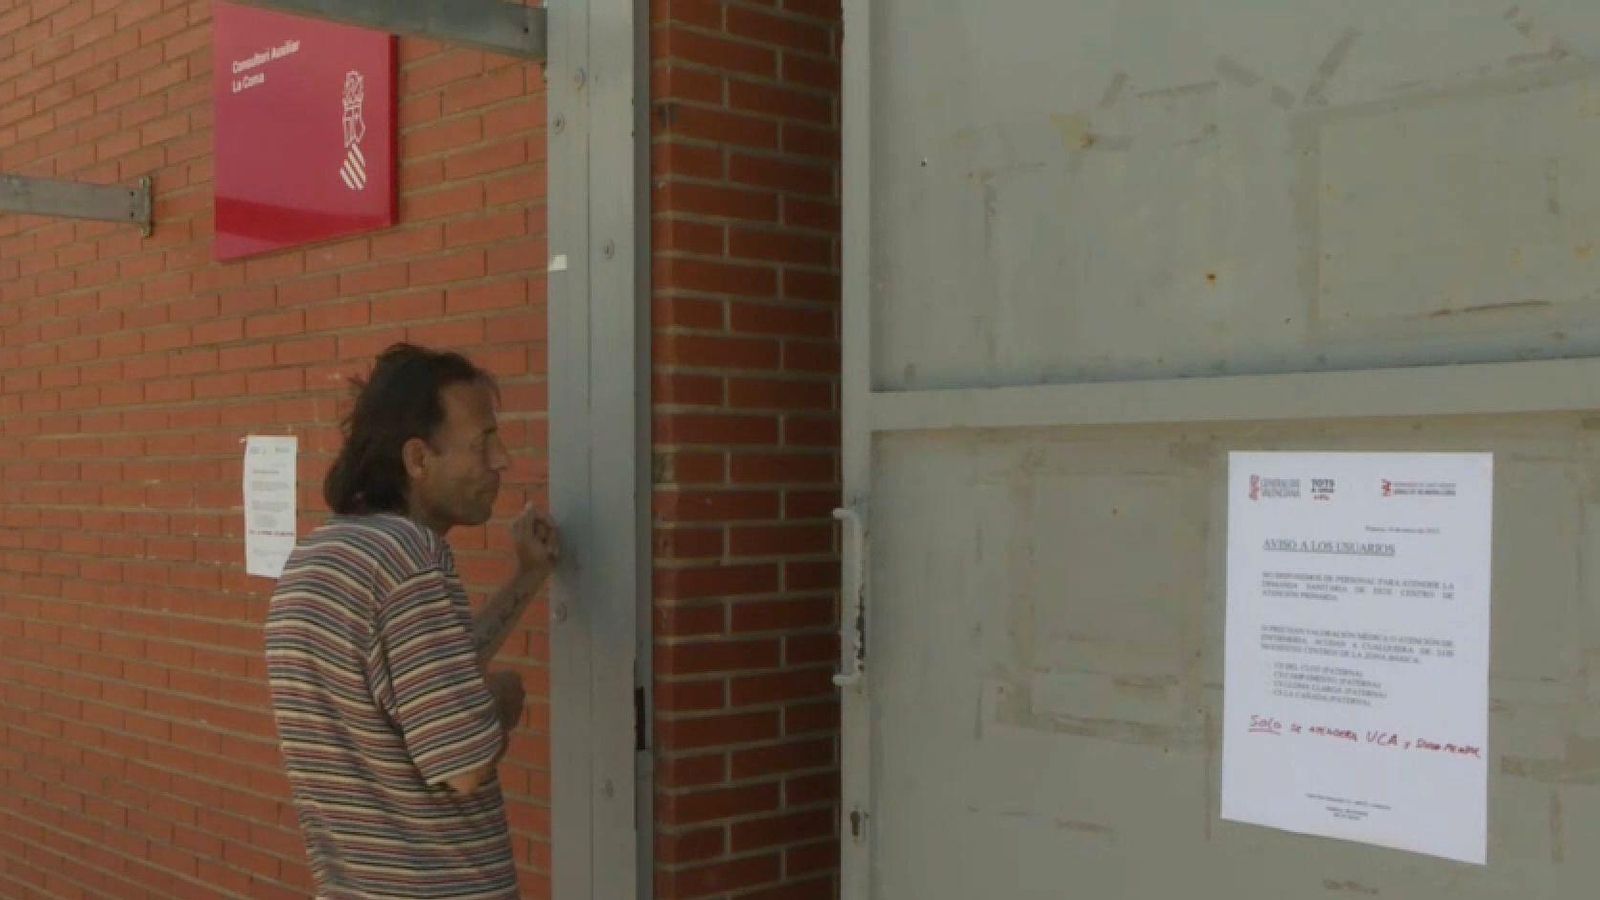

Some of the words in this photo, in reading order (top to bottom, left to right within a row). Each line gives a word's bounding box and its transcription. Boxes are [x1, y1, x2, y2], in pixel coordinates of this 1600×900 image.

[232, 51, 270, 74] Consultori
[271, 39, 300, 60] Auxiliar
[232, 79, 242, 93] La
[243, 72, 265, 89] Coma
[1263, 538, 1297, 552] AVISO
[1299, 540, 1309, 553] A
[1310, 540, 1334, 554] LOS
[1336, 541, 1395, 557] USUARIOS
[1366, 730, 1398, 746] UCA
